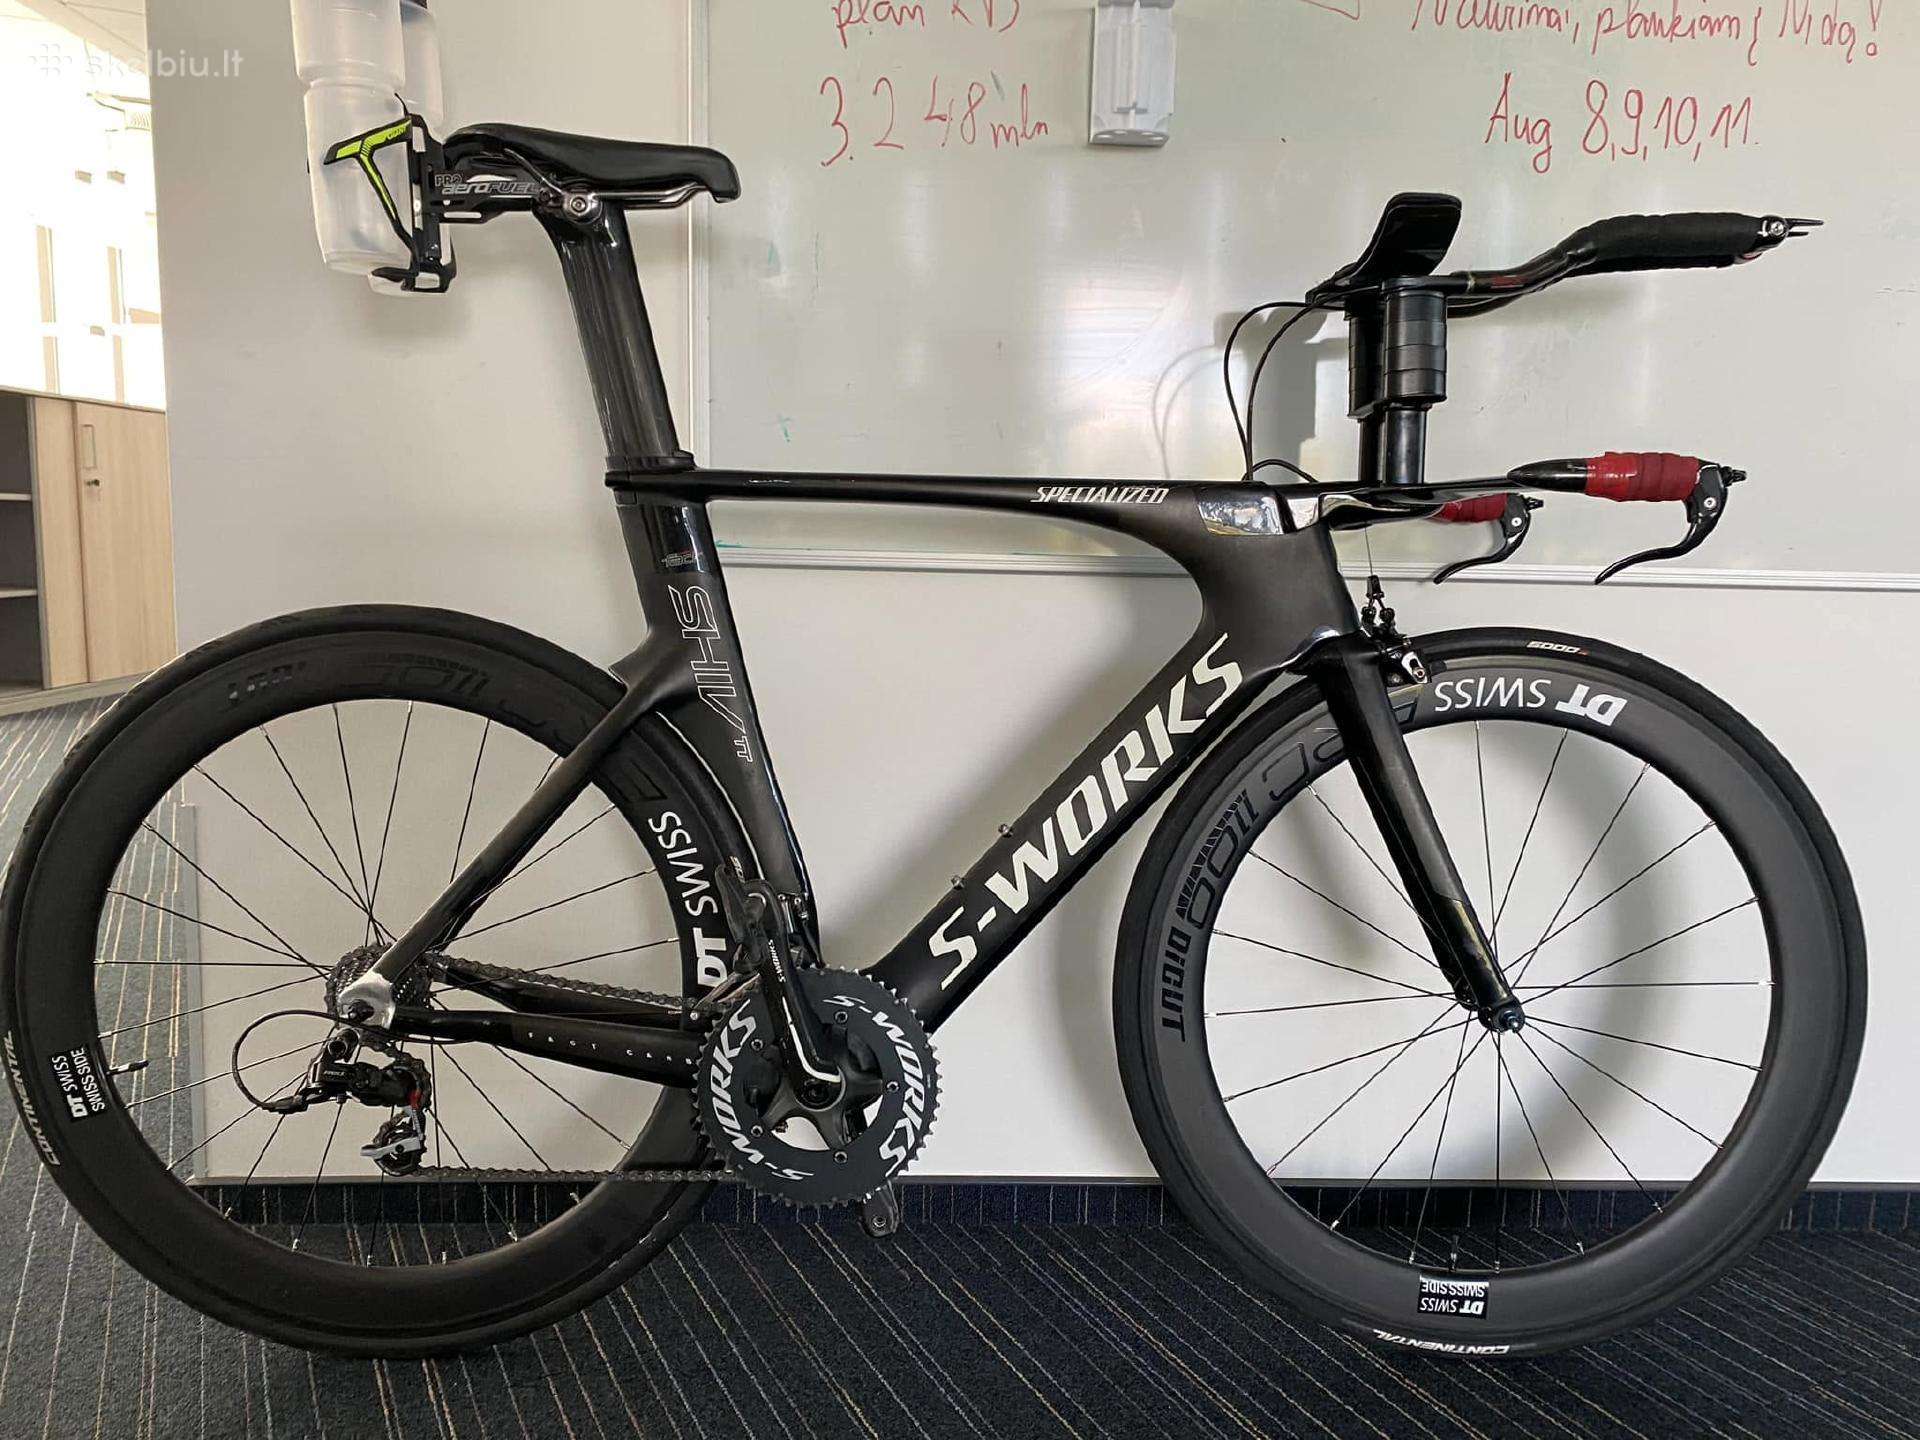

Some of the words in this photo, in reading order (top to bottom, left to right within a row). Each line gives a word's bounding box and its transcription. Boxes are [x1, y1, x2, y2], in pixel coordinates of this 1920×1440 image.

[1484, 72, 1552, 173] Aug
[1030, 486, 1170, 504] SPECIALIZED
[667, 584, 747, 734] SHIV
[1433, 676, 1552, 712] SWISS
[1554, 682, 1628, 727] DT
[927, 632, 1244, 991] S-WORKS
[647, 810, 719, 917] SWISS
[692, 926, 728, 988] DT
[51, 1055, 79, 1093] SWISS
[710, 998, 815, 1180] S-WORKS
[821, 994, 926, 1178] S-WORKS
[66, 1094, 89, 1118] DT
[1419, 1297, 1459, 1313] SWISS
[1459, 1300, 1485, 1316] DT
[1372, 1328, 1511, 1355] CONTINENTAL
